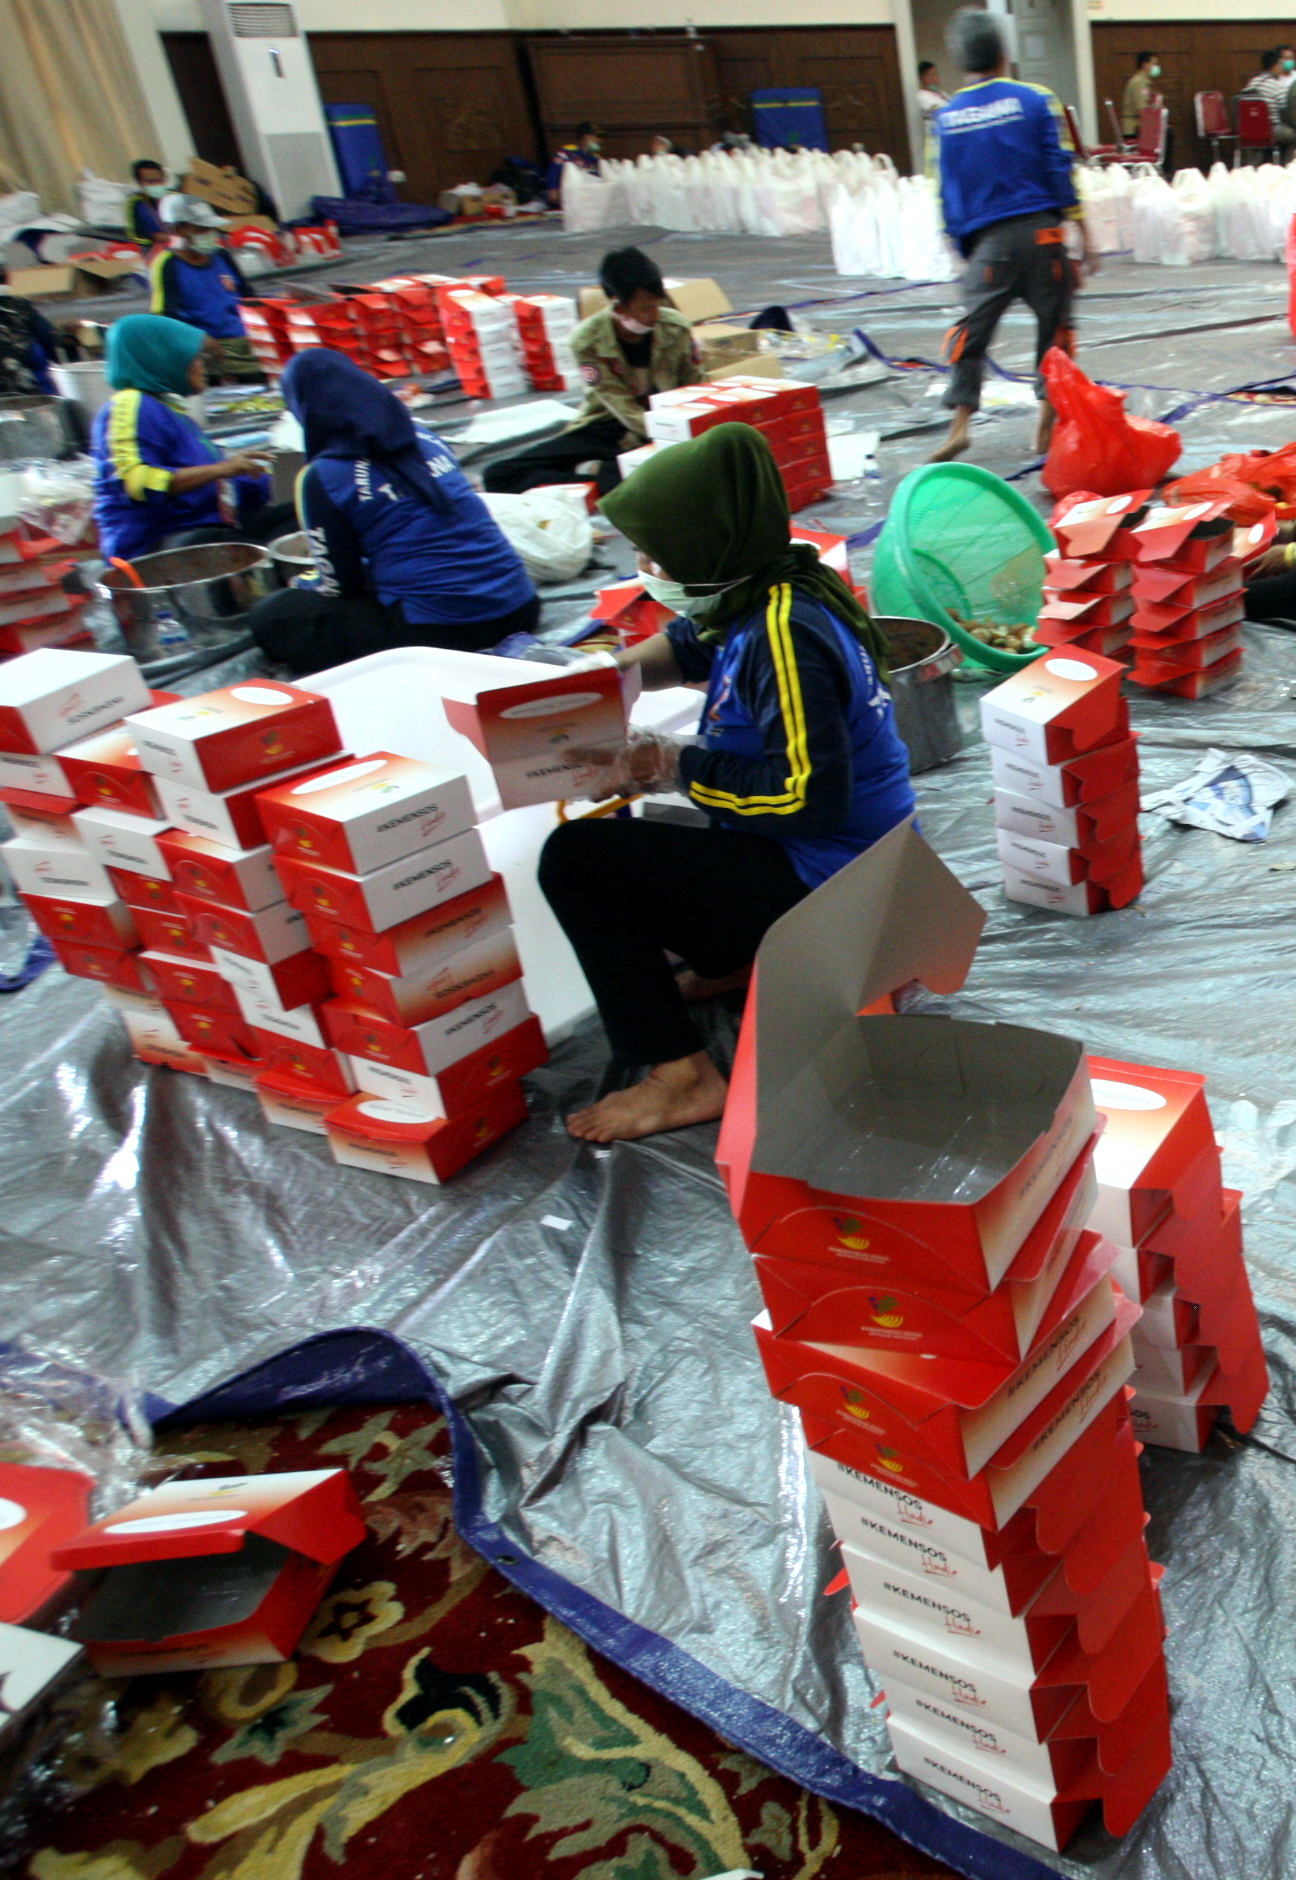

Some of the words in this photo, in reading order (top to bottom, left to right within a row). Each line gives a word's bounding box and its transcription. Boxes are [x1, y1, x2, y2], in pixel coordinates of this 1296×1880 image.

[355, 456, 373, 502] TARUN
[836, 1461, 923, 1511] #KEMENSOS
[861, 1516, 948, 1563] #KEMENSOS
[883, 1581, 972, 1623] #KEMENSOS
[893, 1649, 977, 1693] #KEMENSOS
[915, 1698, 998, 1743] #KEMENSOS
[923, 1756, 1003, 1804] #KEMENSOS
